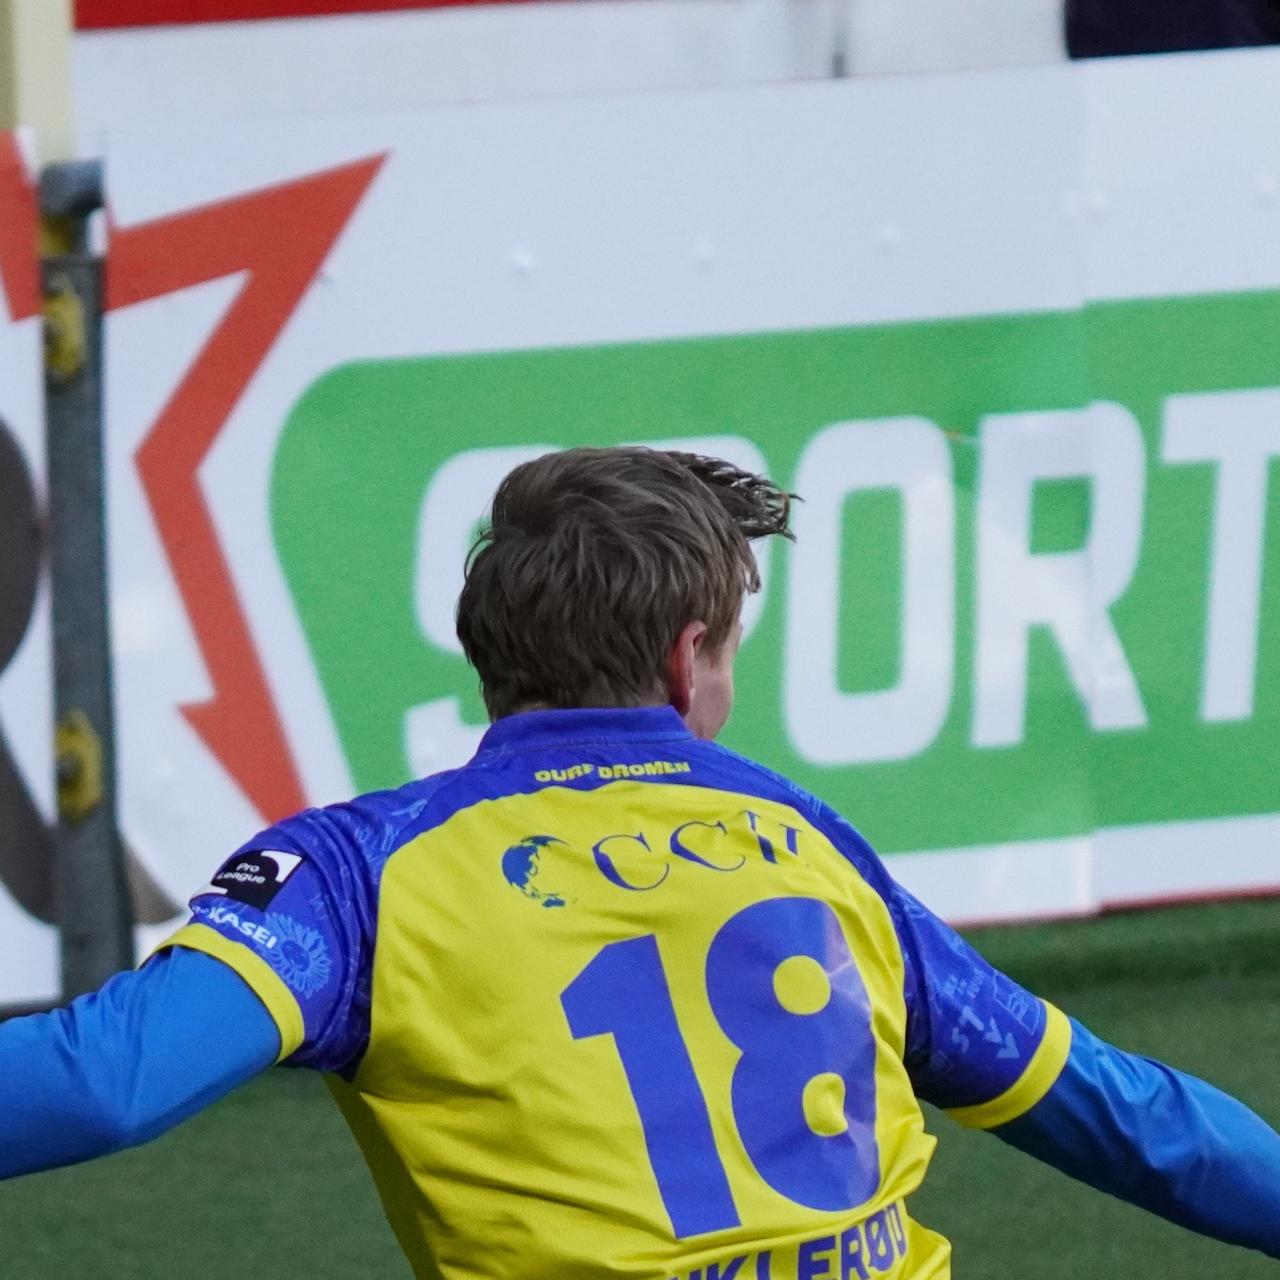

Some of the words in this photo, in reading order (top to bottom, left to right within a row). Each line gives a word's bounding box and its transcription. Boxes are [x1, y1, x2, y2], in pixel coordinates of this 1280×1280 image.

[597, 760, 691, 780] DROMEN
[236, 862, 260, 872] Pro
[560, 896, 881, 1240] 18
